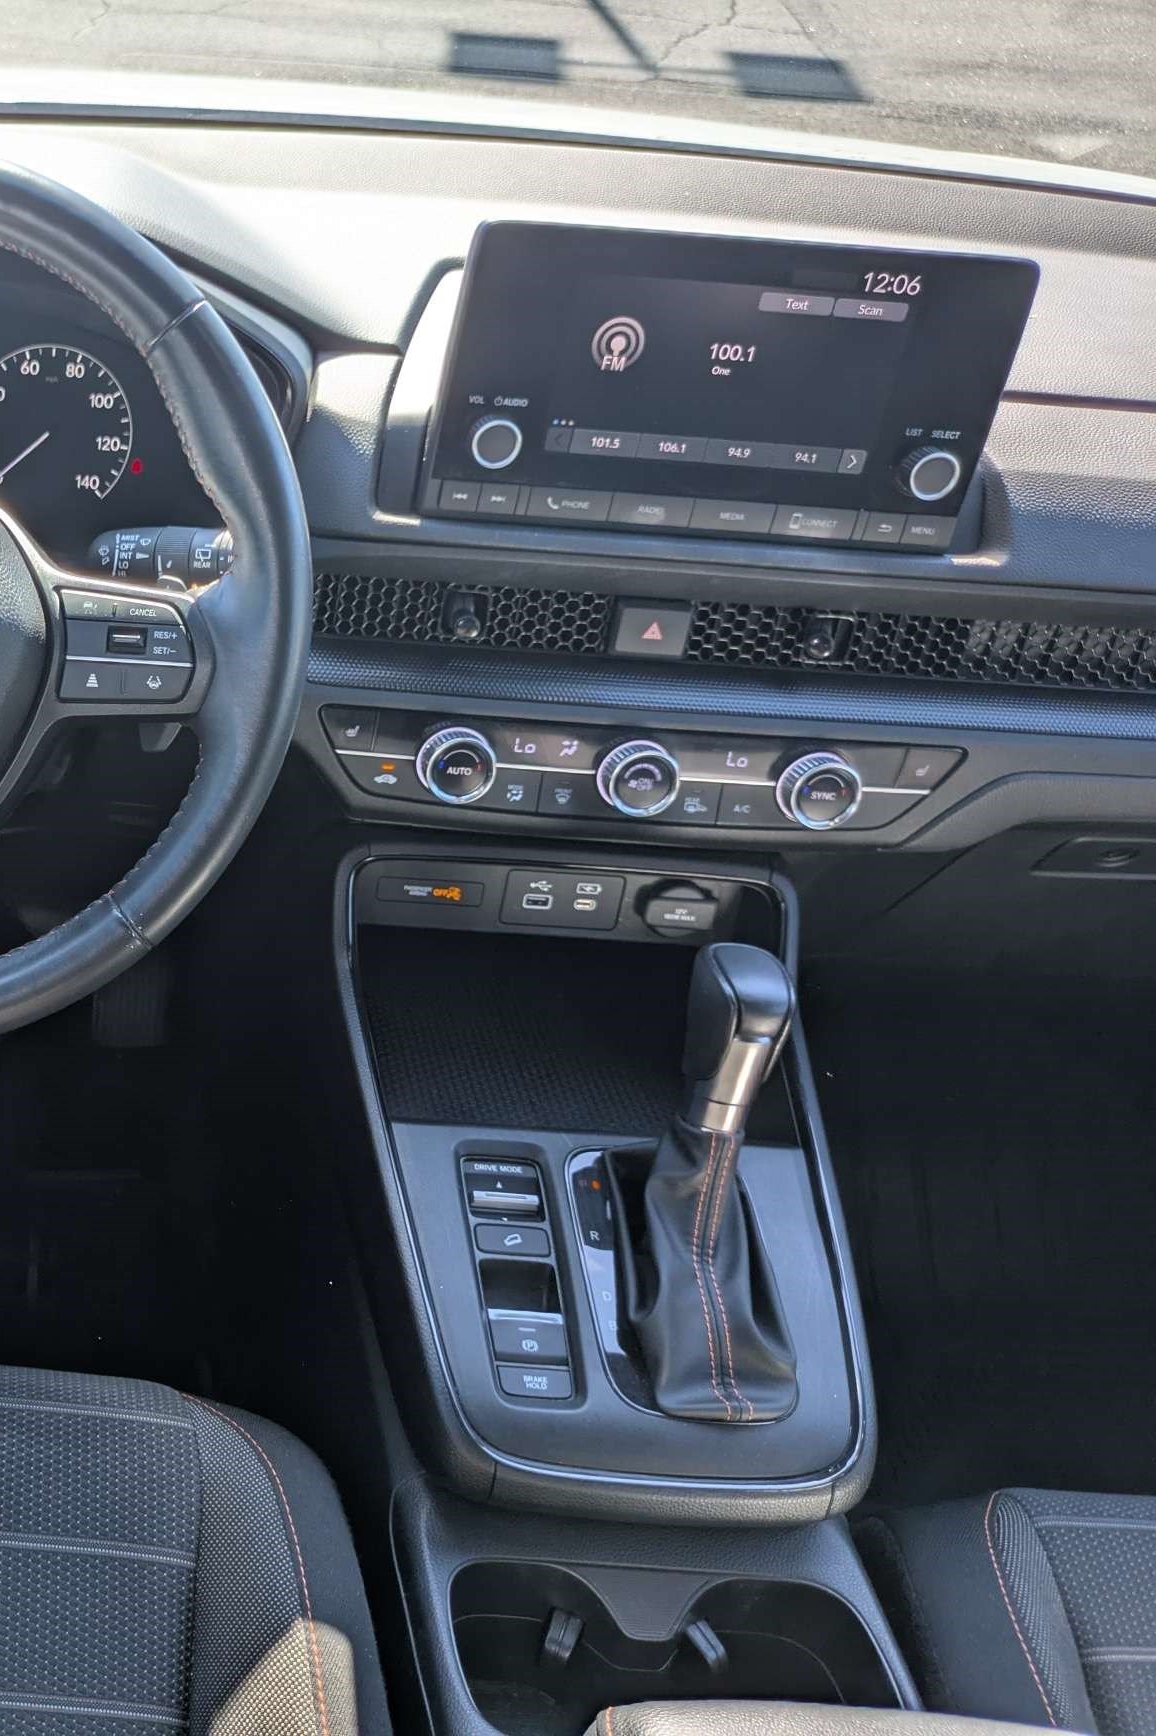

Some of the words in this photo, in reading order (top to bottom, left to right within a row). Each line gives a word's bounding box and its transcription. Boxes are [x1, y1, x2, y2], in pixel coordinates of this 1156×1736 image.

[864, 272, 921, 295] 12:06
[785, 298, 809, 311] Text
[858, 304, 883, 317] Scan
[709, 343, 756, 362] 100.1
[20, 361, 40, 376] 60
[600, 355, 626, 372] FM
[65, 363, 85, 379] 80
[711, 365, 731, 376] One
[89, 393, 114, 410] 100
[469, 395, 485, 404] VOL
[503, 397, 529, 408] AUDIO
[905, 428, 923, 437] LIST
[931, 430, 961, 440] SELECT
[96, 436, 120, 452] 120
[591, 436, 621, 449] 101.5
[658, 441, 686, 454] 106.1
[727, 447, 750, 459] 94.9
[795, 452, 817, 464] 94.1
[75, 474, 100, 490] 140
[560, 500, 590, 510] PHONE
[719, 511, 745, 521] MEDIA
[801, 518, 838, 529] CONNECT
[910, 526, 935, 536] MENU
[119, 552, 133, 560] INT
[118, 562, 129, 570] LO
[193, 561, 211, 569] REAR
[130, 608, 157, 618] CANCEL
[446, 766, 473, 776] AUTO
[810, 790, 837, 801] SYNC
[733, 804, 751, 814] A/C
[474, 1163, 498, 1173] DRIVE
[499, 1164, 523, 1175] MODE
[589, 1230, 600, 1241] R
[523, 1374, 548, 1384] BRAKE
[525, 1382, 548, 1390] HOLD
